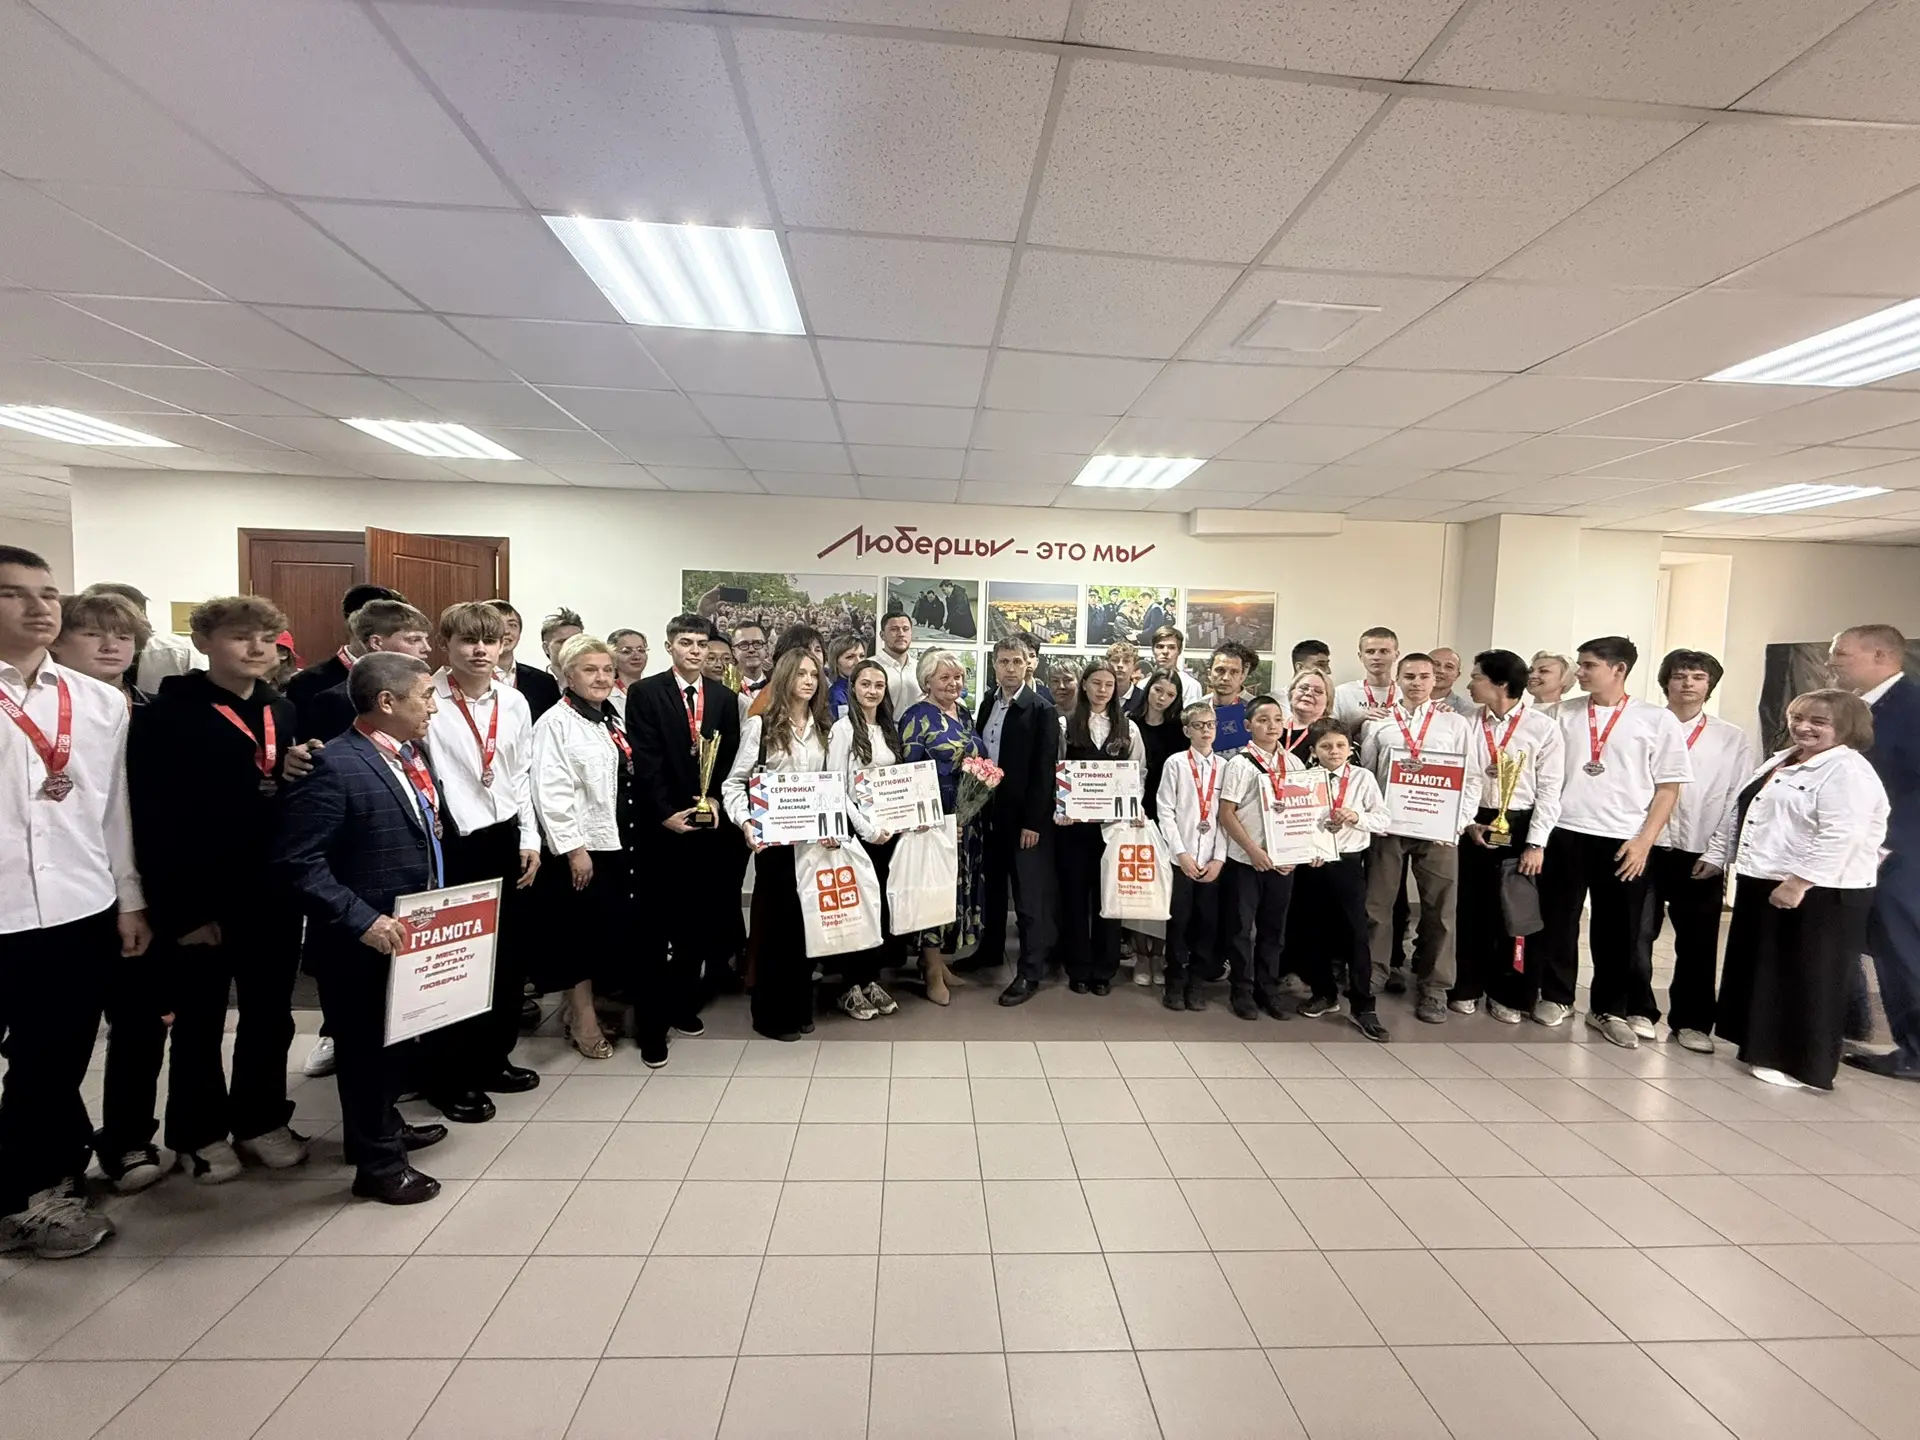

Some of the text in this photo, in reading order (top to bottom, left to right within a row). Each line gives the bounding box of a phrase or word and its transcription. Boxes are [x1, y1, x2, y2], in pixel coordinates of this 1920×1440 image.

[817, 525, 1015, 564] Люберцы
[0, 697, 24, 718] 2026
[57, 734, 70, 753] 2026
[873, 776, 913, 788] СЕРТИФИКАТ
[1399, 772, 1452, 788] ГРАМОТА
[1281, 795, 1320, 807] АМОТА
[410, 918, 483, 949] ГРАМОТА
[435, 946, 467, 960] МЕСТО
[414, 953, 476, 974] ПО ФУТЗАЛУ
[419, 972, 468, 991] ЛЮБЕРЦЫ
